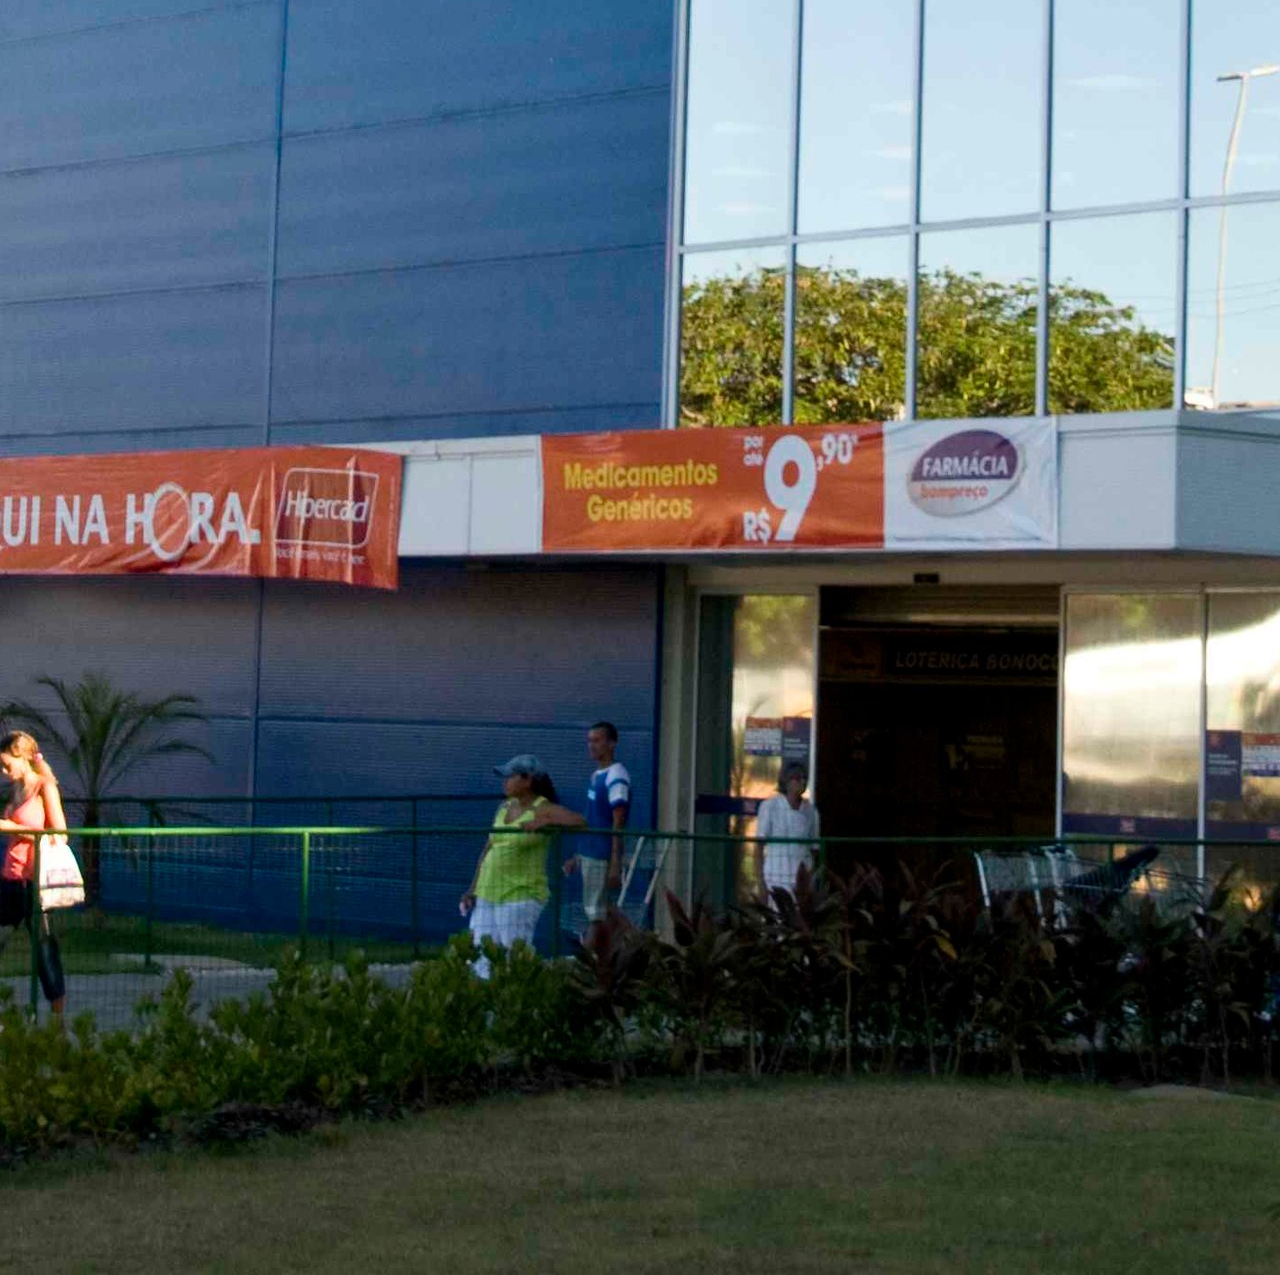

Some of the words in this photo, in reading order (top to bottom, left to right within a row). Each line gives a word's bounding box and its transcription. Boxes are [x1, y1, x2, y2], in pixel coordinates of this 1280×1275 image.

[564, 460, 718, 491] Medicamentos
[922, 450, 1009, 477] FARMÁCIA
[285, 490, 370, 523] Hipercad
[587, 487, 693, 522] Genéricos
[920, 482, 988, 501] bompreço
[56, 493, 110, 546] NA
[126, 481, 261, 562] HORA.
[743, 506, 772, 545] R$
